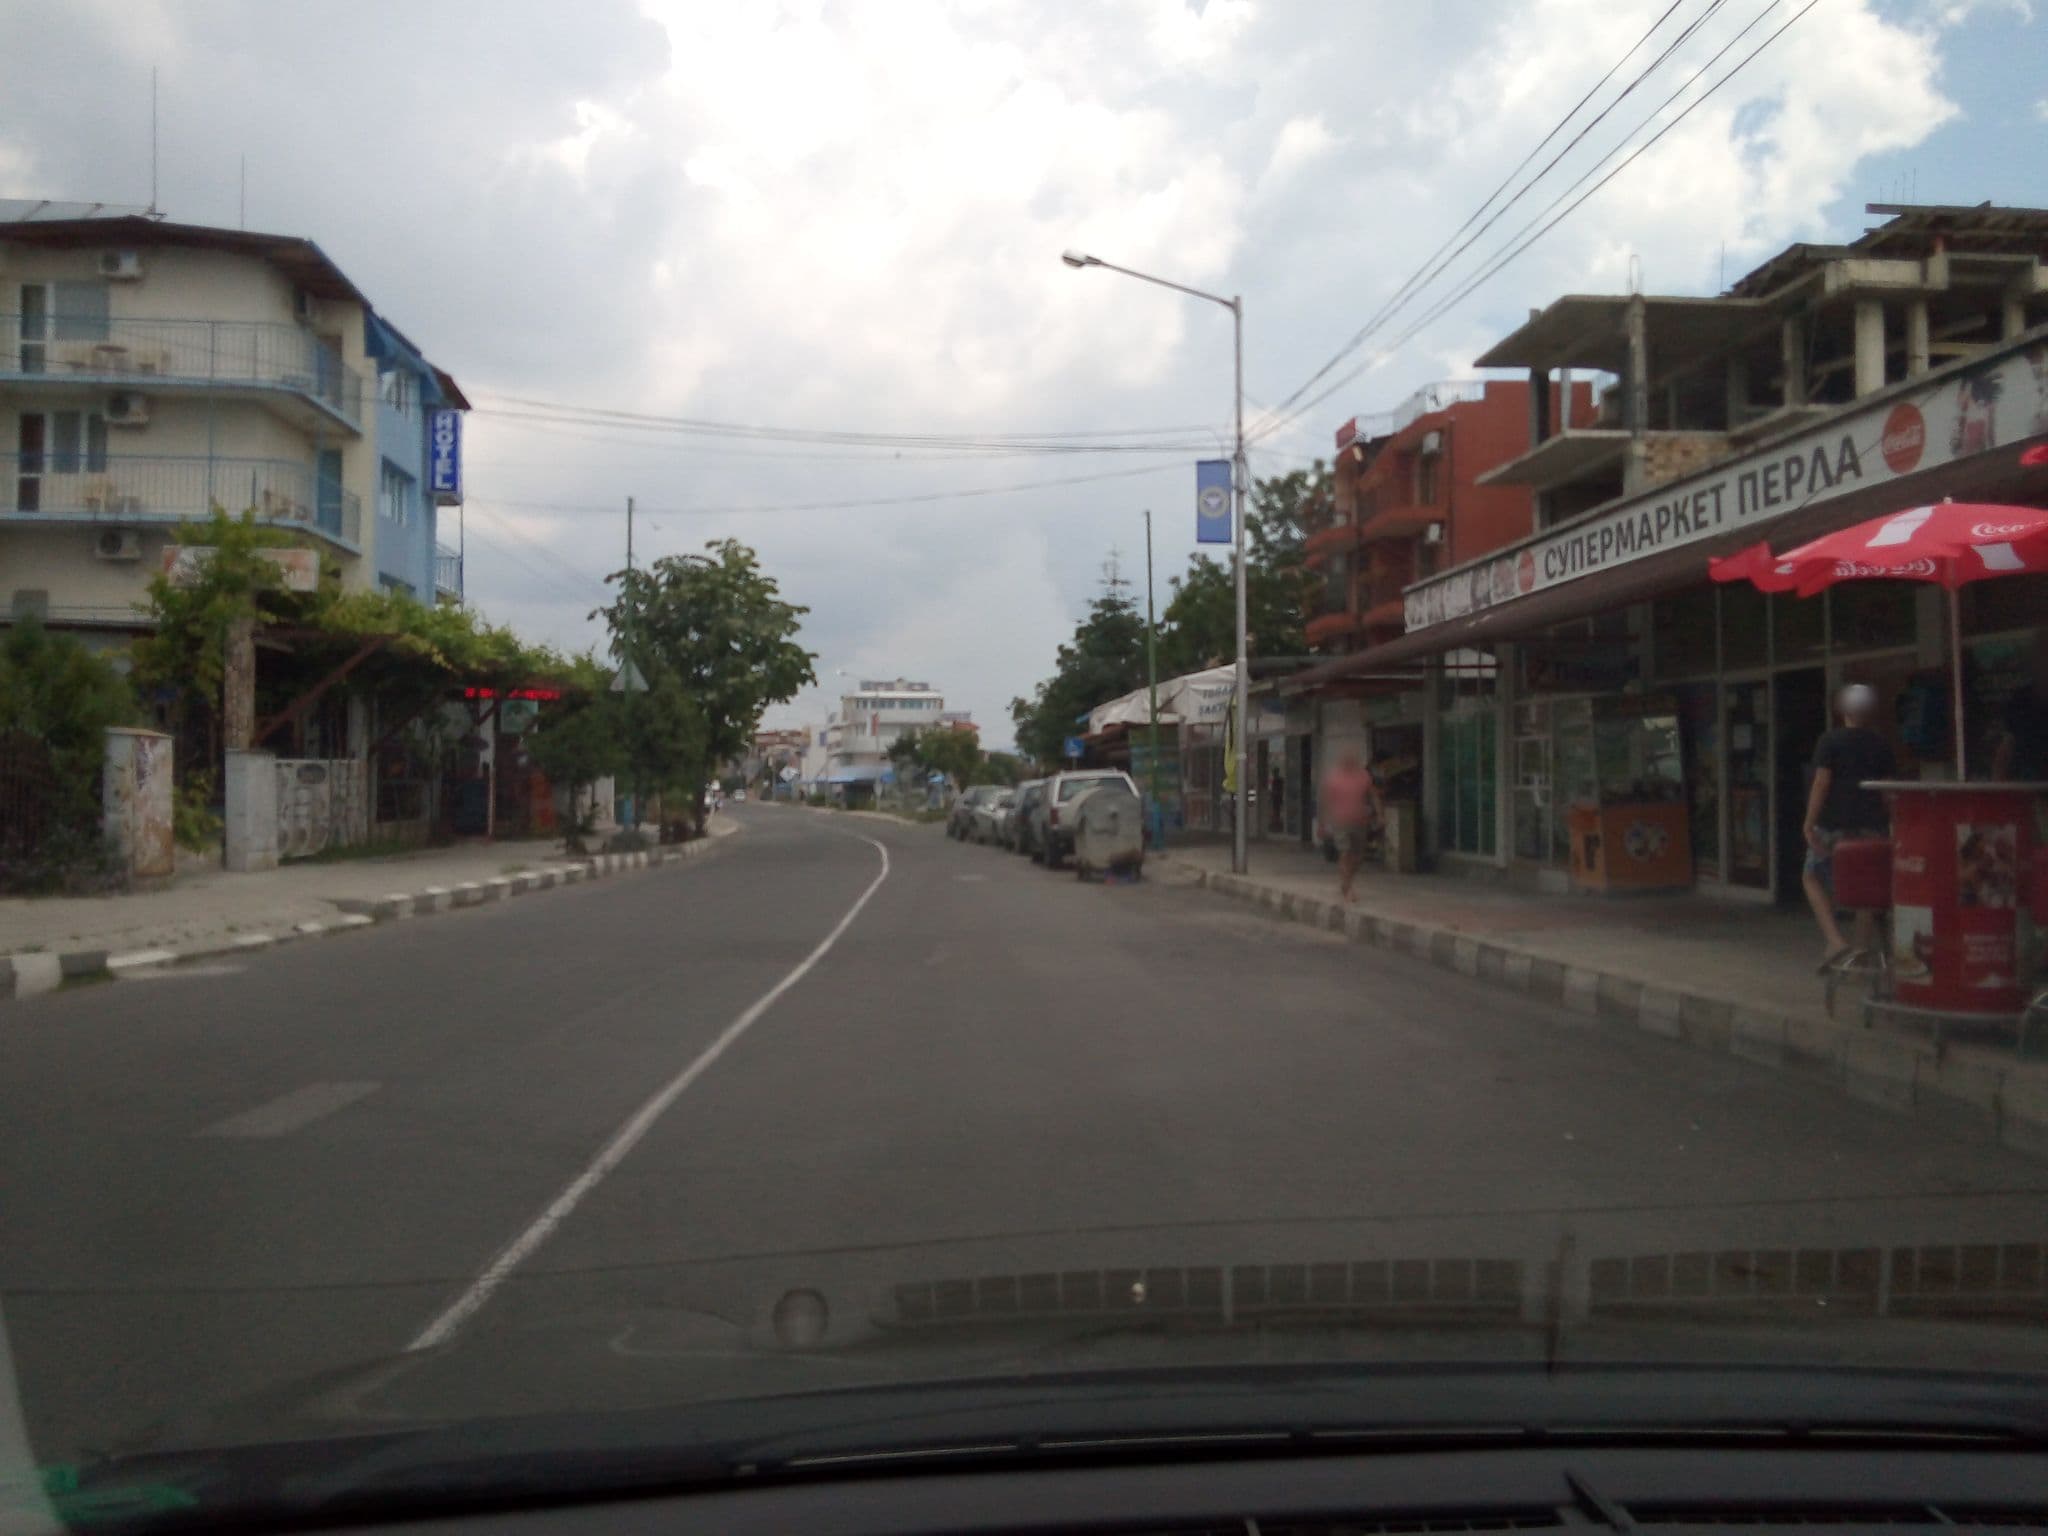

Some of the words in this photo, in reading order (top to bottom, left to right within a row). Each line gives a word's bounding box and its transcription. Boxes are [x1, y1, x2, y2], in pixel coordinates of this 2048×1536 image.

[435, 415, 455, 490] HOTEL
[1543, 482, 1728, 581] СУПЕРМАРКЕТ
[1737, 432, 1864, 516] ПЕРЛА
